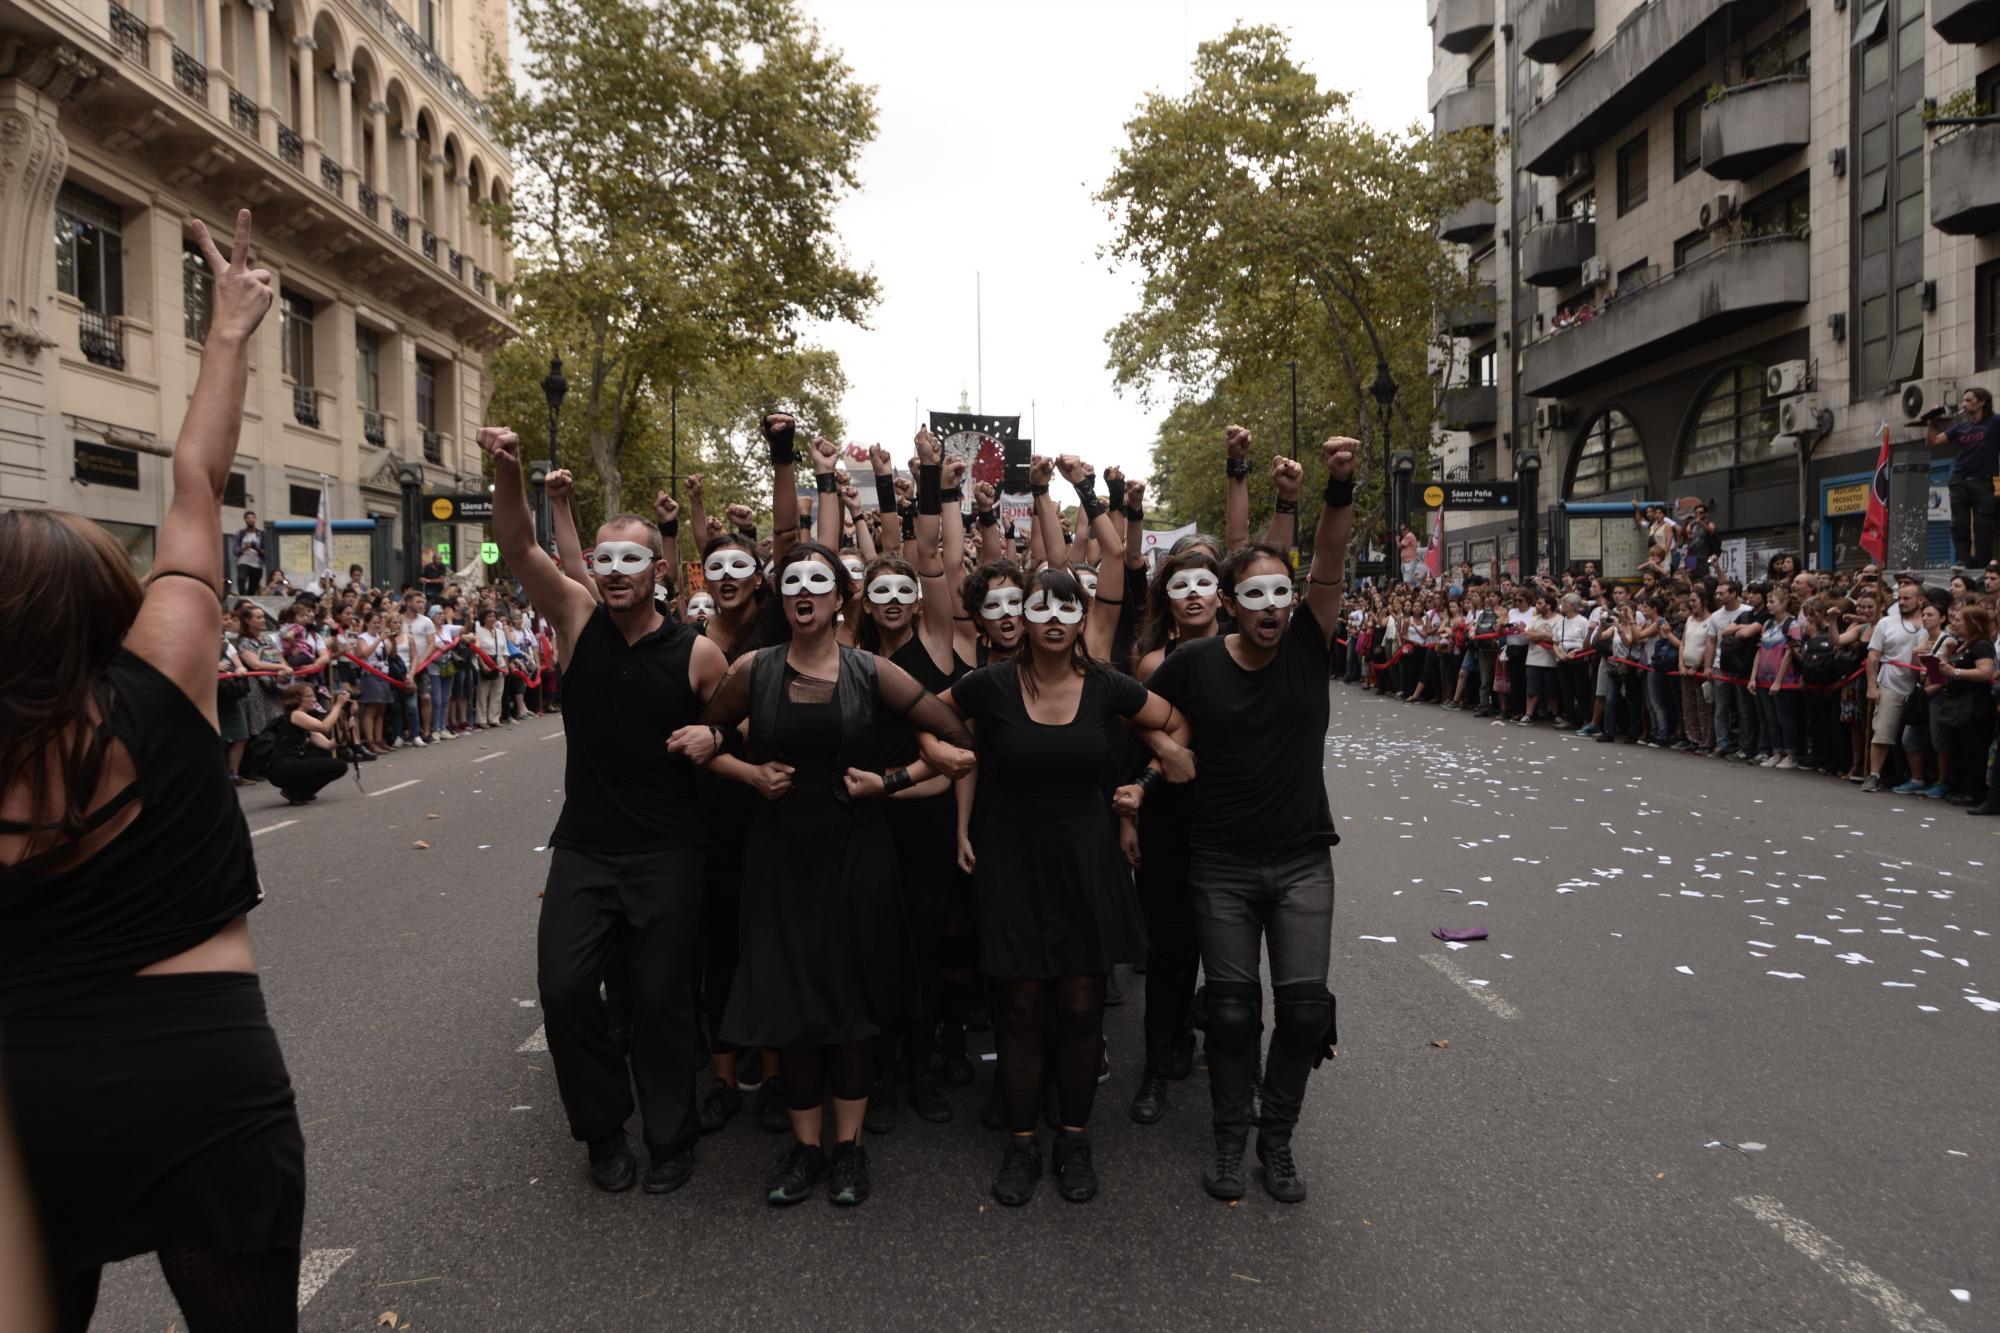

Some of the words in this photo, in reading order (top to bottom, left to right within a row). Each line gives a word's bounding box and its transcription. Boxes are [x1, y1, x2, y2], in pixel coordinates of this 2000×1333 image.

[1451, 489, 1473, 498] Sáenz
[1474, 489, 1492, 498] Peña
[1832, 494, 1863, 503] PRODUCTOS
[460, 502, 482, 511] Sáenz
[1834, 503, 1861, 513] CALZADOS
